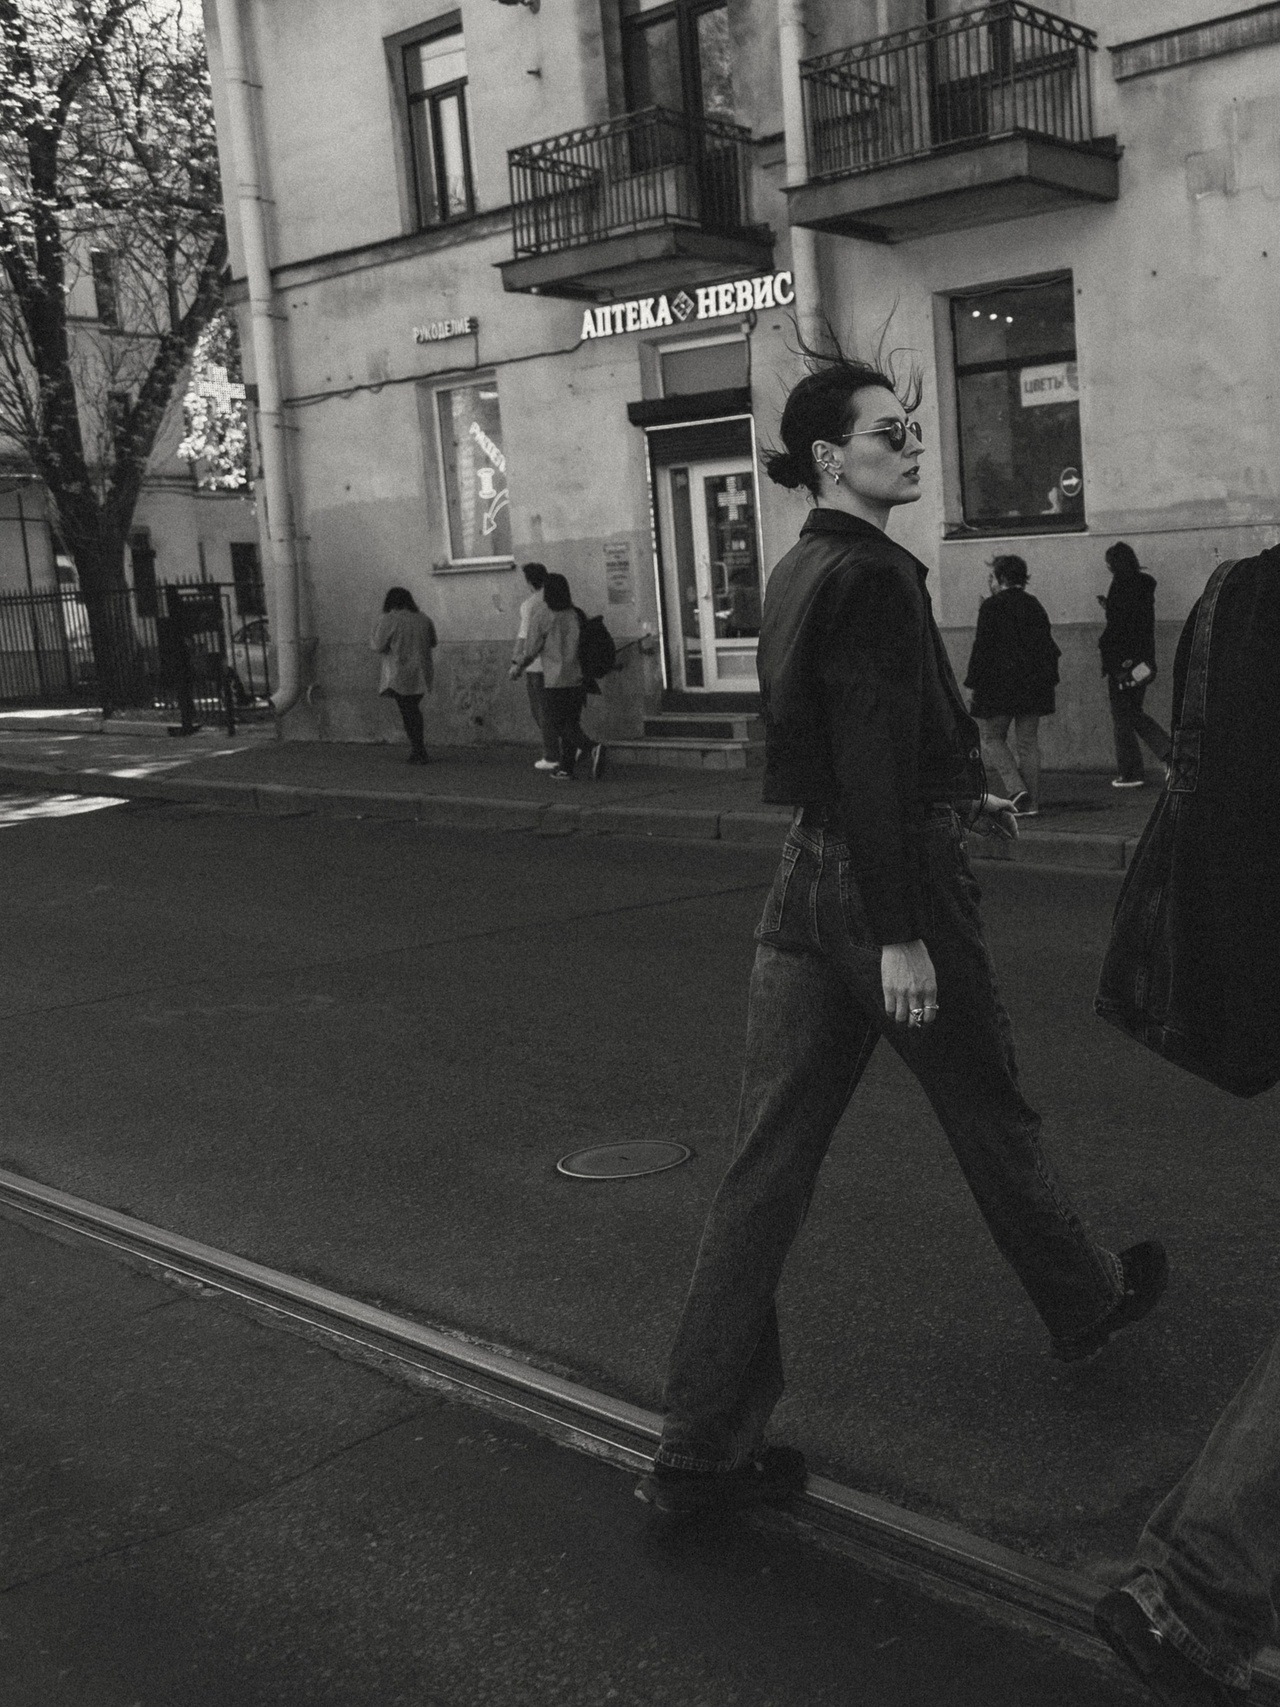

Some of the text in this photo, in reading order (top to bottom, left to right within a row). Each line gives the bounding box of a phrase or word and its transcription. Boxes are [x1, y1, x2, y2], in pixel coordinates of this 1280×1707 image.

[412, 317, 471, 343] РУКОДЕЛИЕ
[581, 271, 795, 341] АПТЕКА НЕВИС
